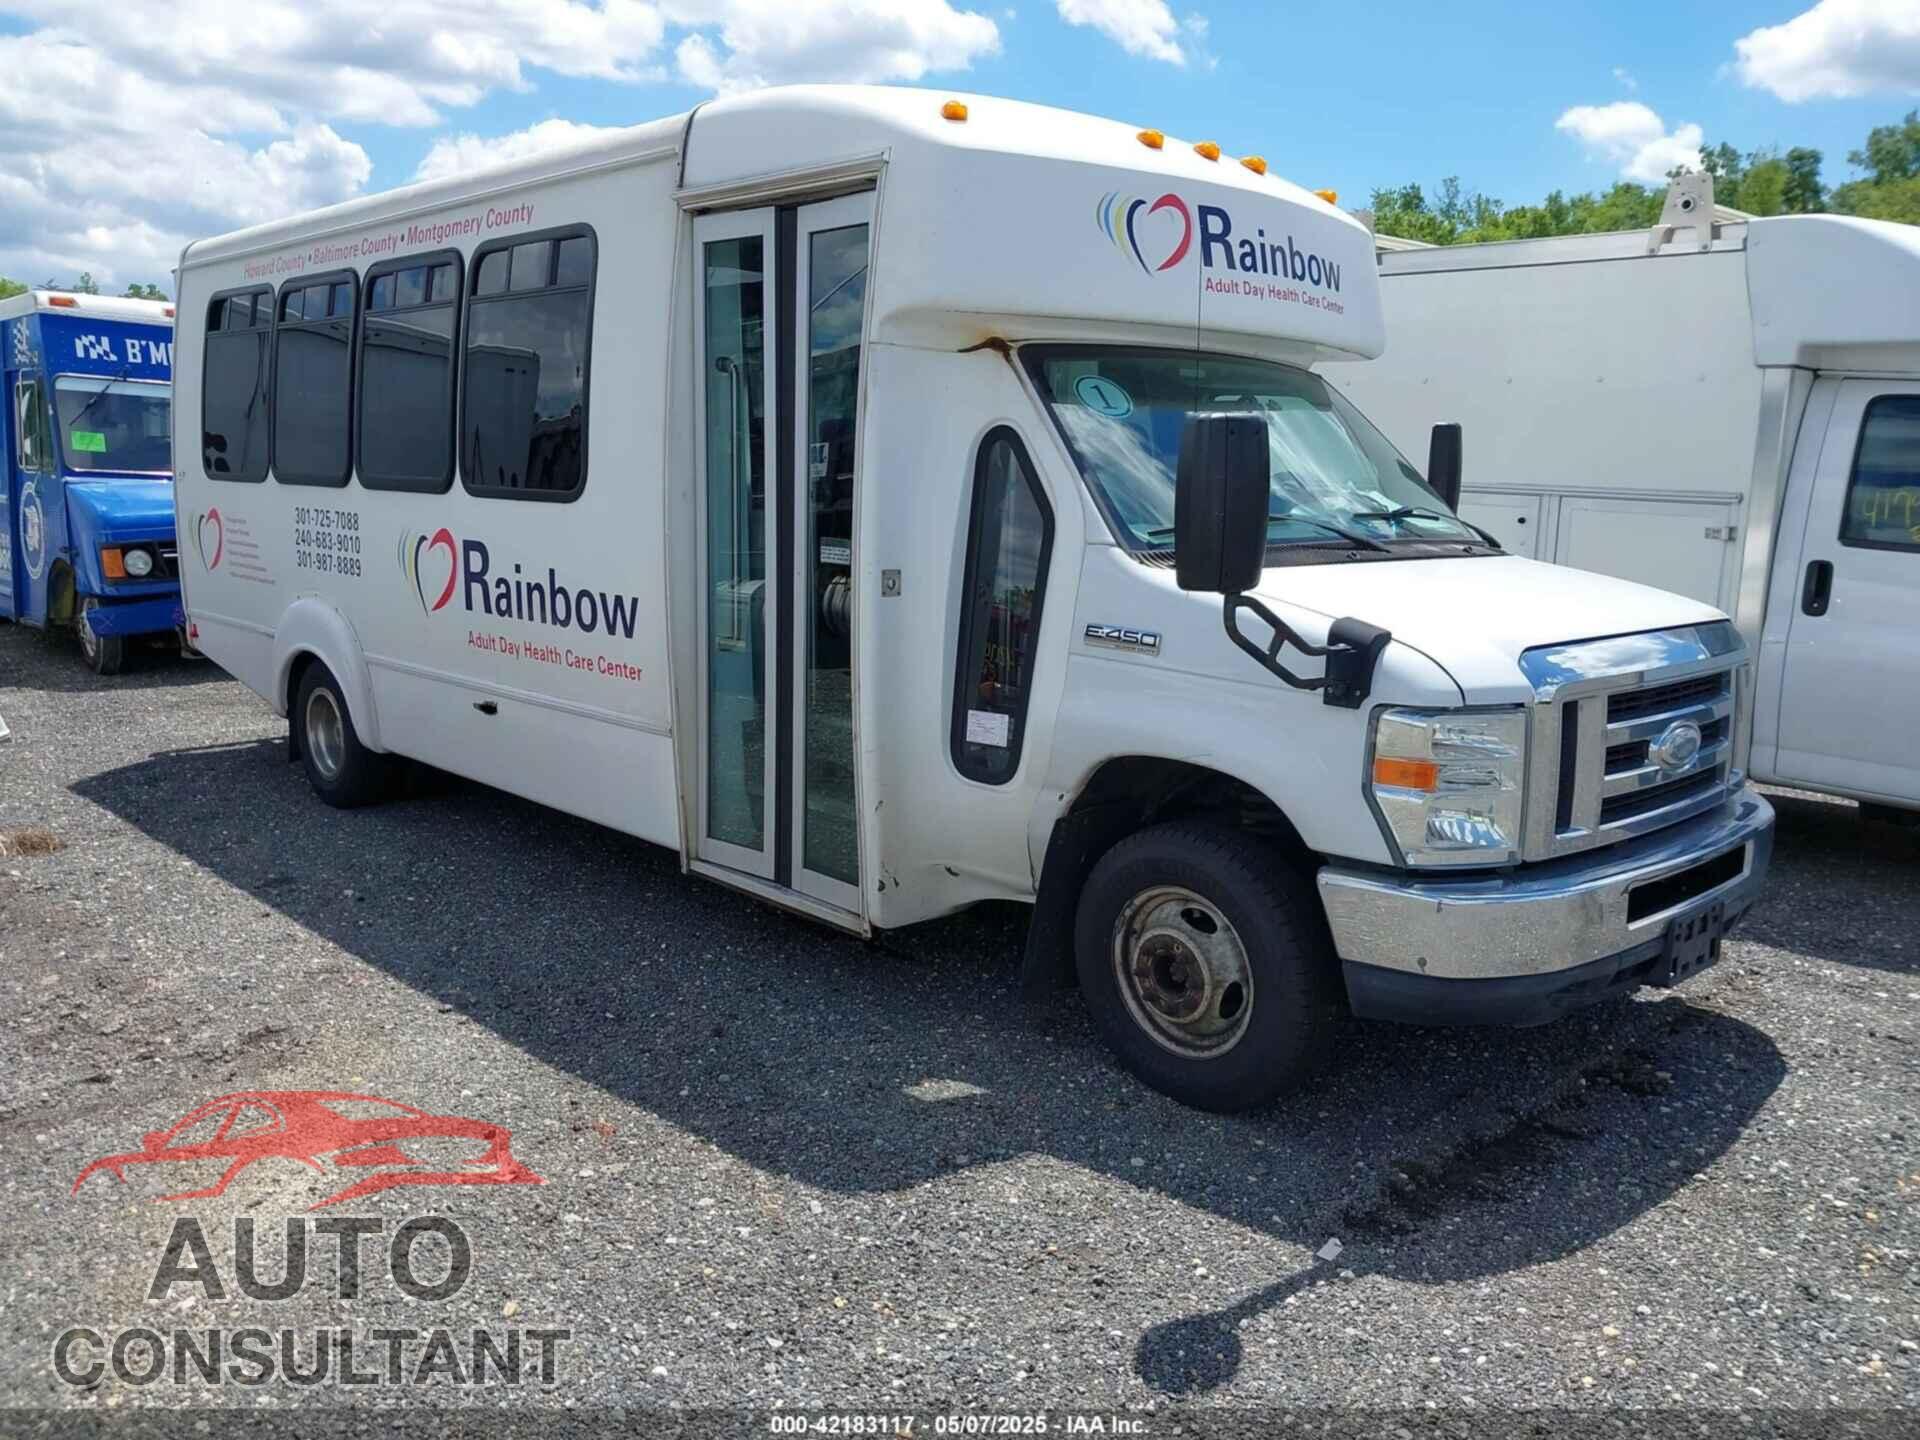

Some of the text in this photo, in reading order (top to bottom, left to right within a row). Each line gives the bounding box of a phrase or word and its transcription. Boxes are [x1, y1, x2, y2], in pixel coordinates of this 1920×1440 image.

[313, 243, 359, 264] Baltimore
[361, 230, 398, 256] County
[406, 215, 483, 246] Montgomery
[486, 202, 534, 229] County
[1197, 204, 1341, 293] Rainbow
[1205, 277, 1345, 315] Adult Day Health Care Center
[125, 338, 174, 366] B'M
[1091, 385, 1118, 409] 1
[295, 507, 359, 531] 301-725-7088
[295, 529, 361, 554] 240-683-9010
[296, 550, 361, 577] 301-987-8889
[462, 539, 639, 639] Rainbow
[468, 631, 642, 682] Adult Day Health Care Center
